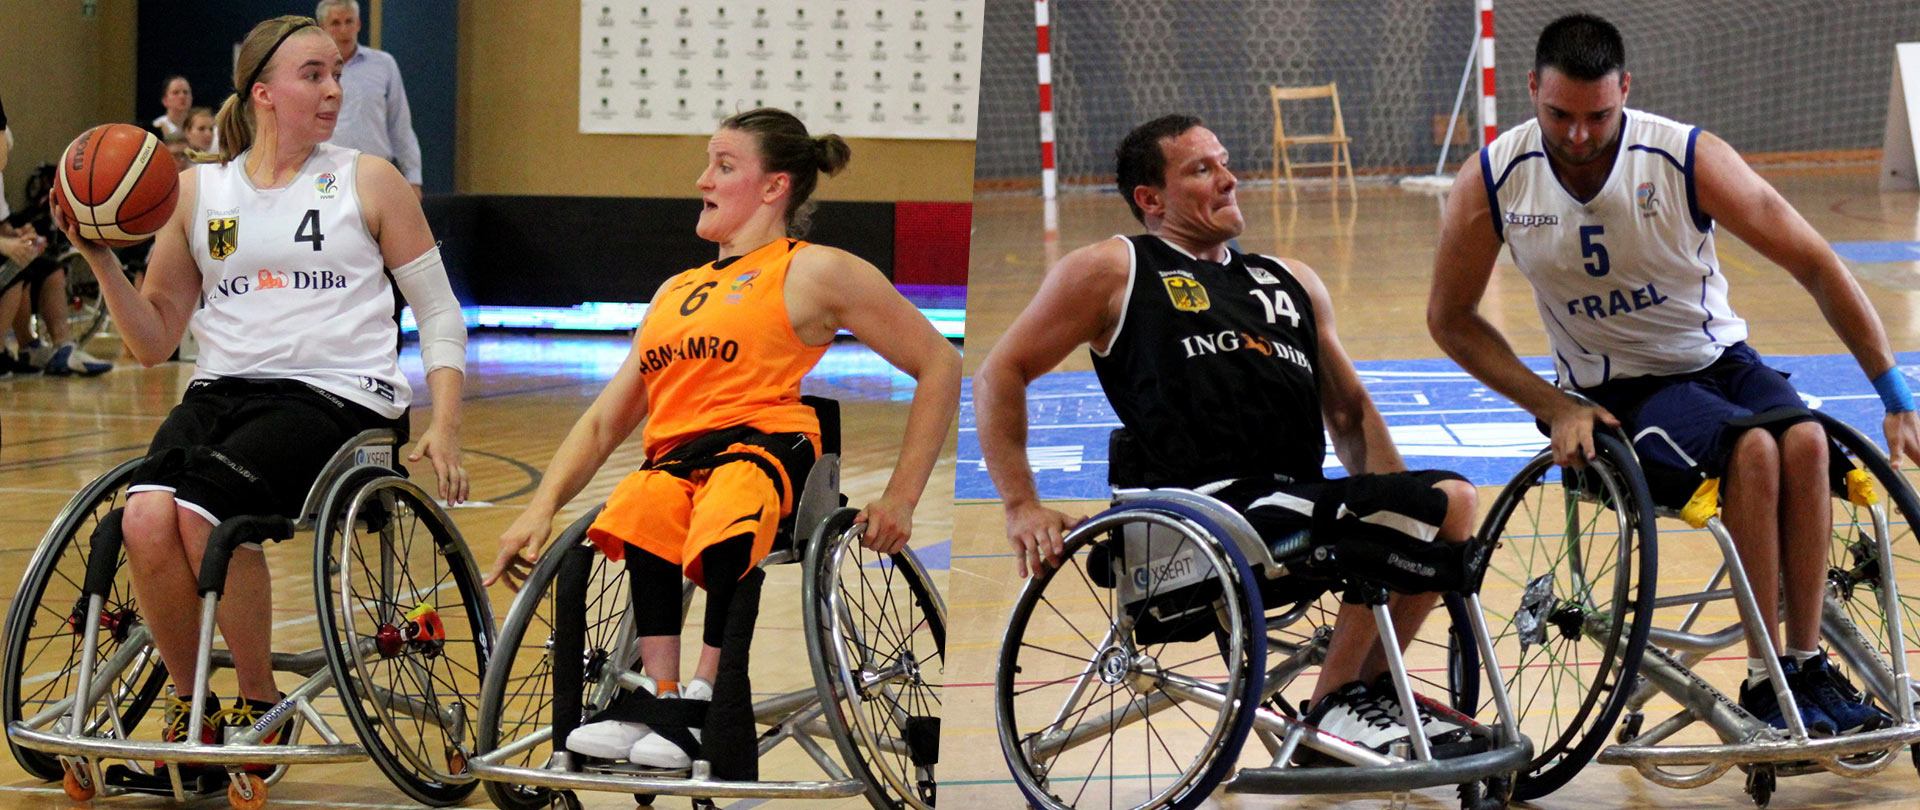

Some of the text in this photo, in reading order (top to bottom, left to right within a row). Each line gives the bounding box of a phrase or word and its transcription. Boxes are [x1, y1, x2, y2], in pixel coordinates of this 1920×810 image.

[294, 209, 325, 252] 4
[1505, 211, 1558, 227] Kappa
[1579, 225, 1610, 278] 5
[209, 270, 347, 300] NG DiBa
[680, 281, 718, 316] 6
[1567, 283, 1668, 320] RAEL
[1249, 289, 1300, 328] 14
[1181, 330, 1240, 359] ING
[1151, 557, 1191, 584] XSEAT
